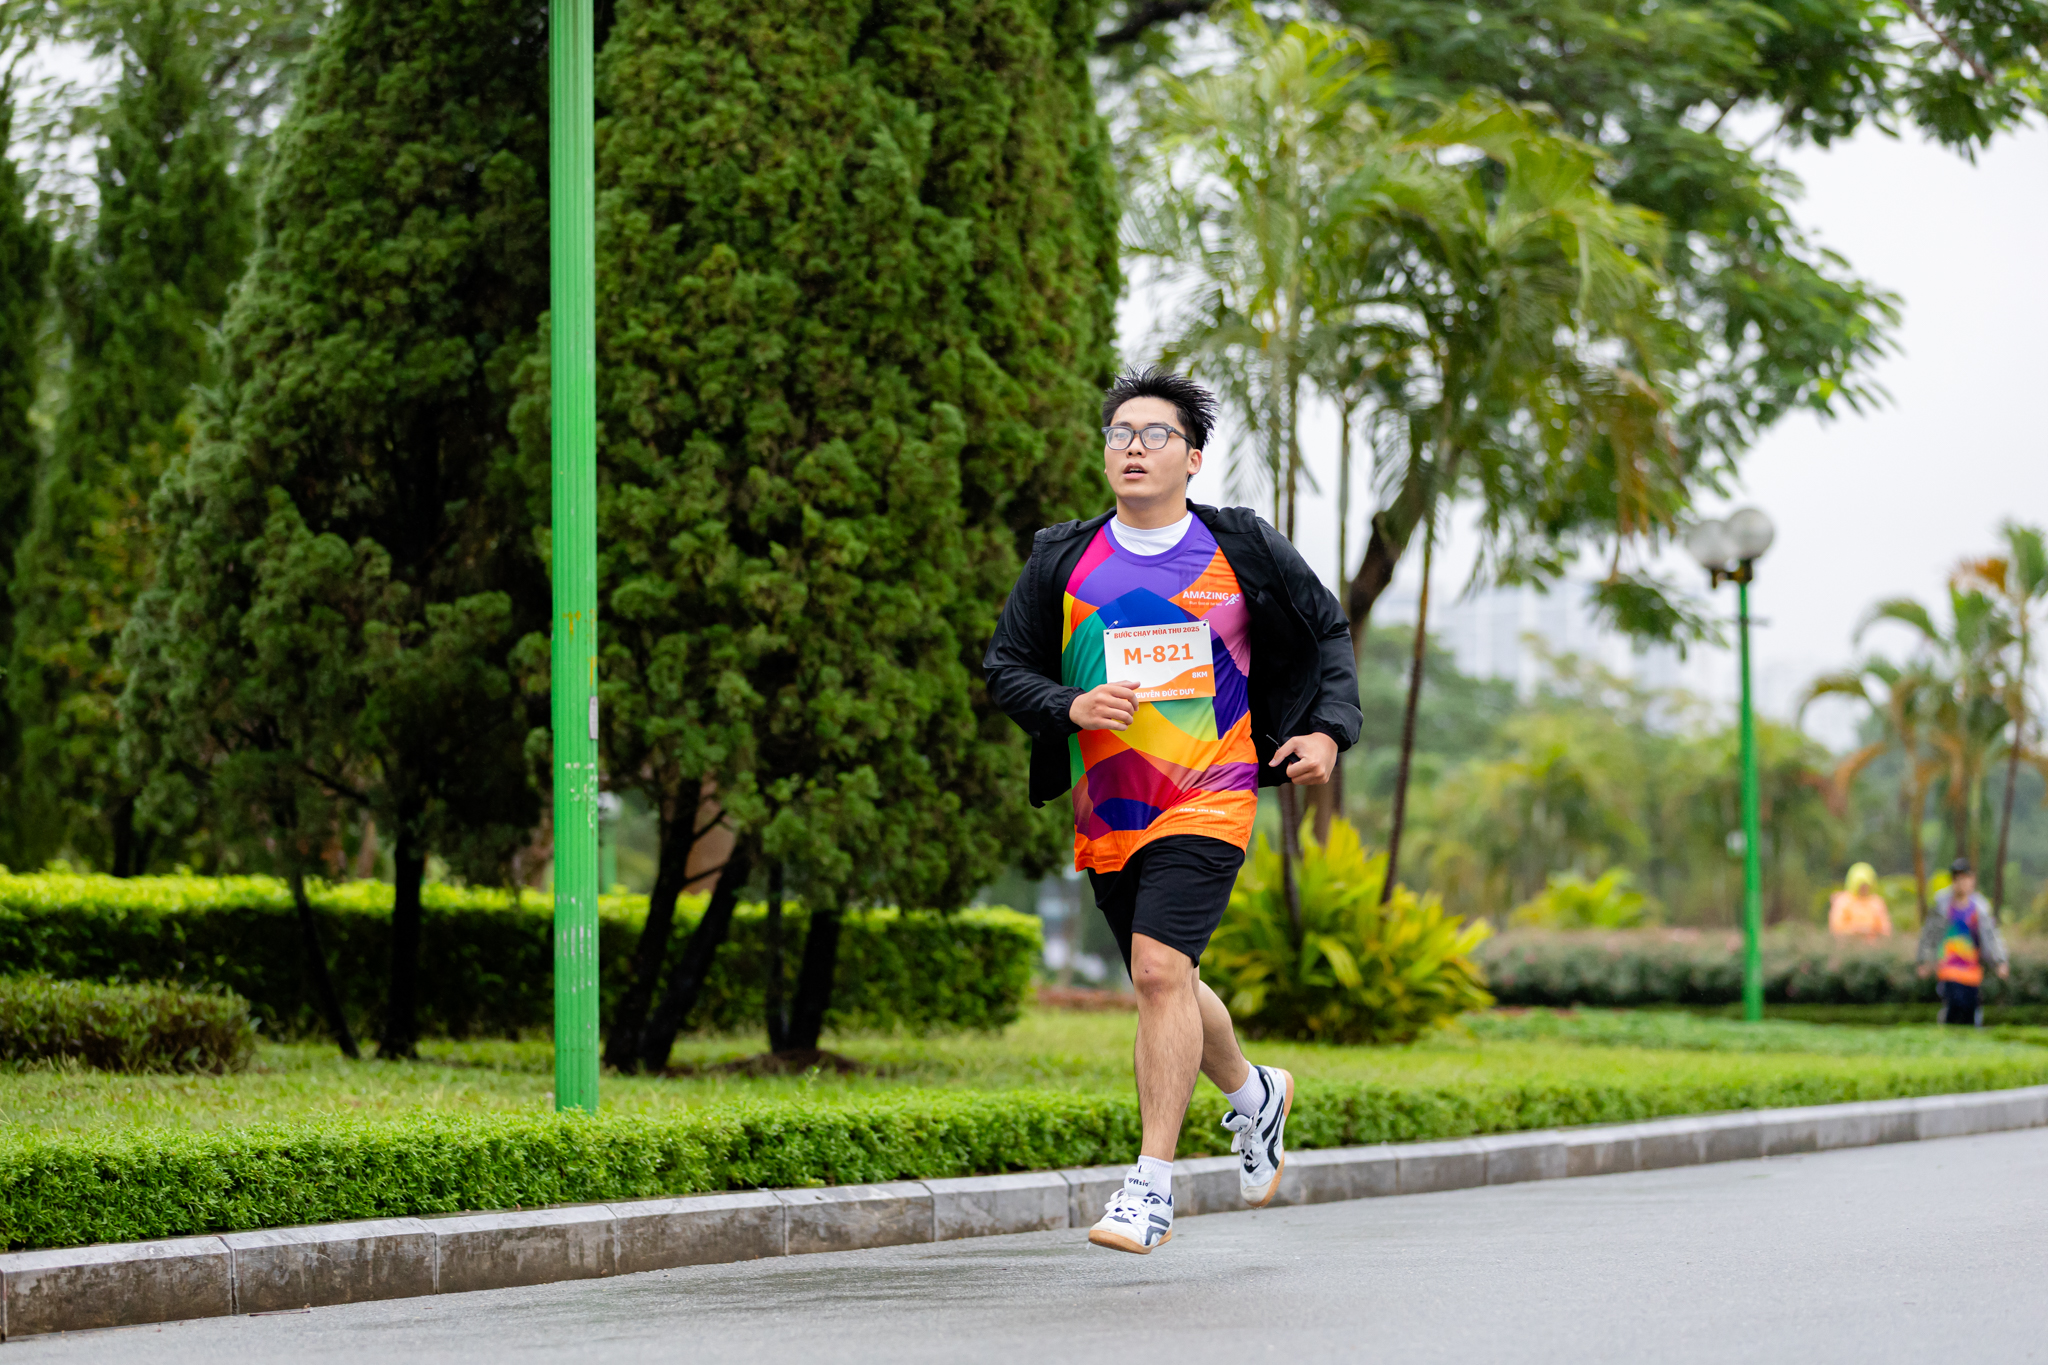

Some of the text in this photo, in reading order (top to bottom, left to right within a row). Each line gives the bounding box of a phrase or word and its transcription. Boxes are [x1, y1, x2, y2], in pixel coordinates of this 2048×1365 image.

[1182, 591, 1229, 600] AMAZING
[1133, 630, 1151, 638] CHẠY
[1152, 627, 1168, 636] MÙA
[1168, 627, 1182, 635] THU
[1124, 643, 1194, 665] M-821
[1191, 671, 1208, 679] 8KM
[1135, 687, 1195, 699] GUYỄN ĐỨC DUY
